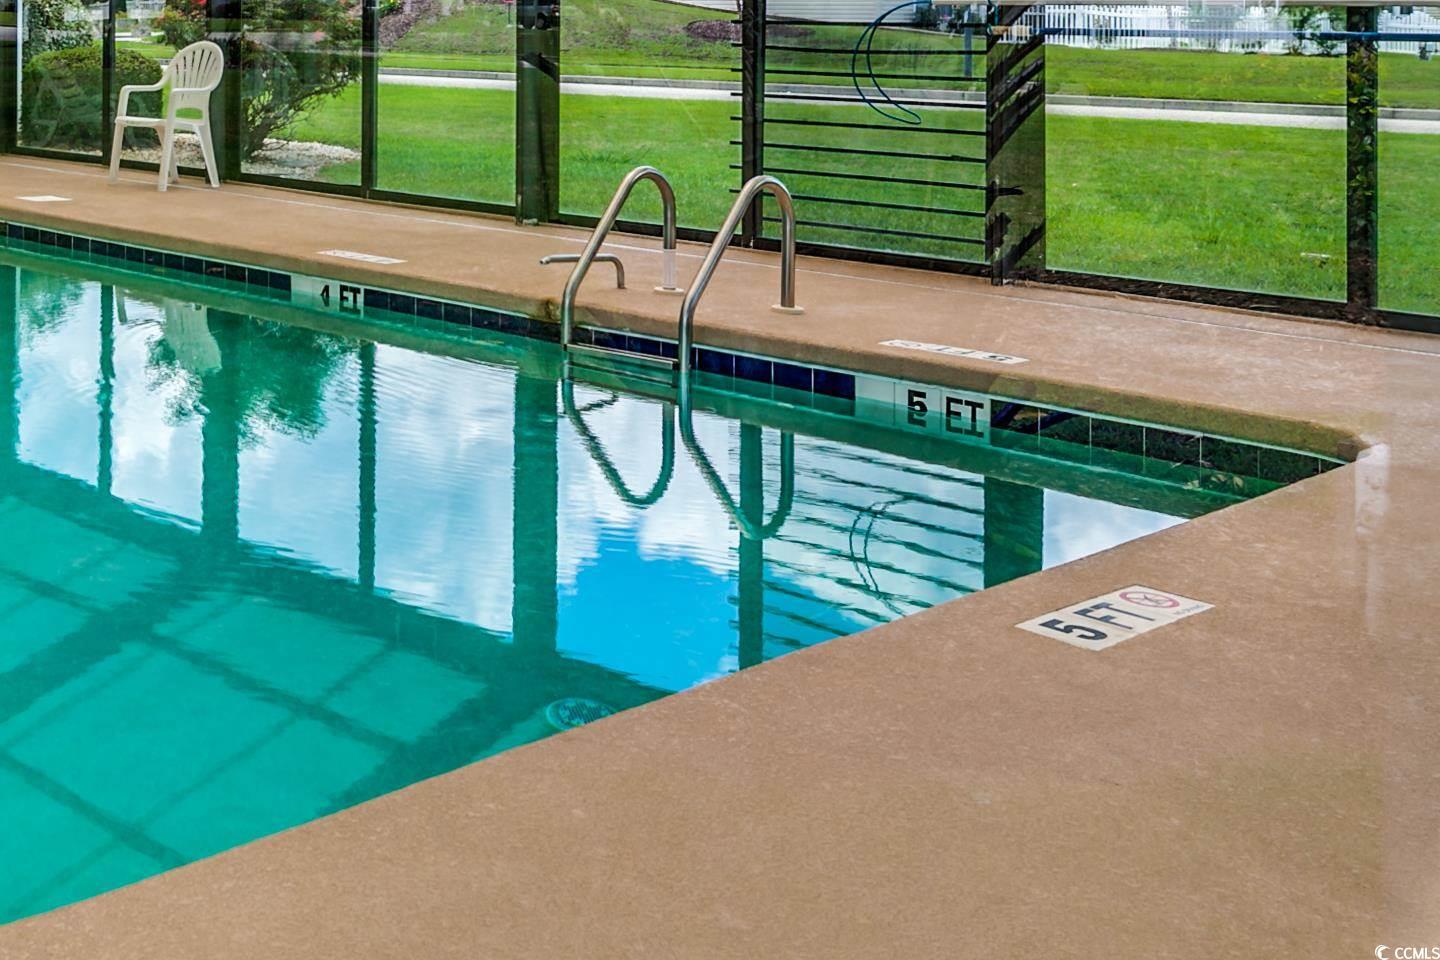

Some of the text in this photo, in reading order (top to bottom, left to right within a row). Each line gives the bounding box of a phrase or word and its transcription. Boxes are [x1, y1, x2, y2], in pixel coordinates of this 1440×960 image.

[339, 284, 361, 306] FT
[907, 389, 984, 426] 5 FT
[1038, 618, 1108, 641] 5
[1073, 601, 1156, 630] FT
